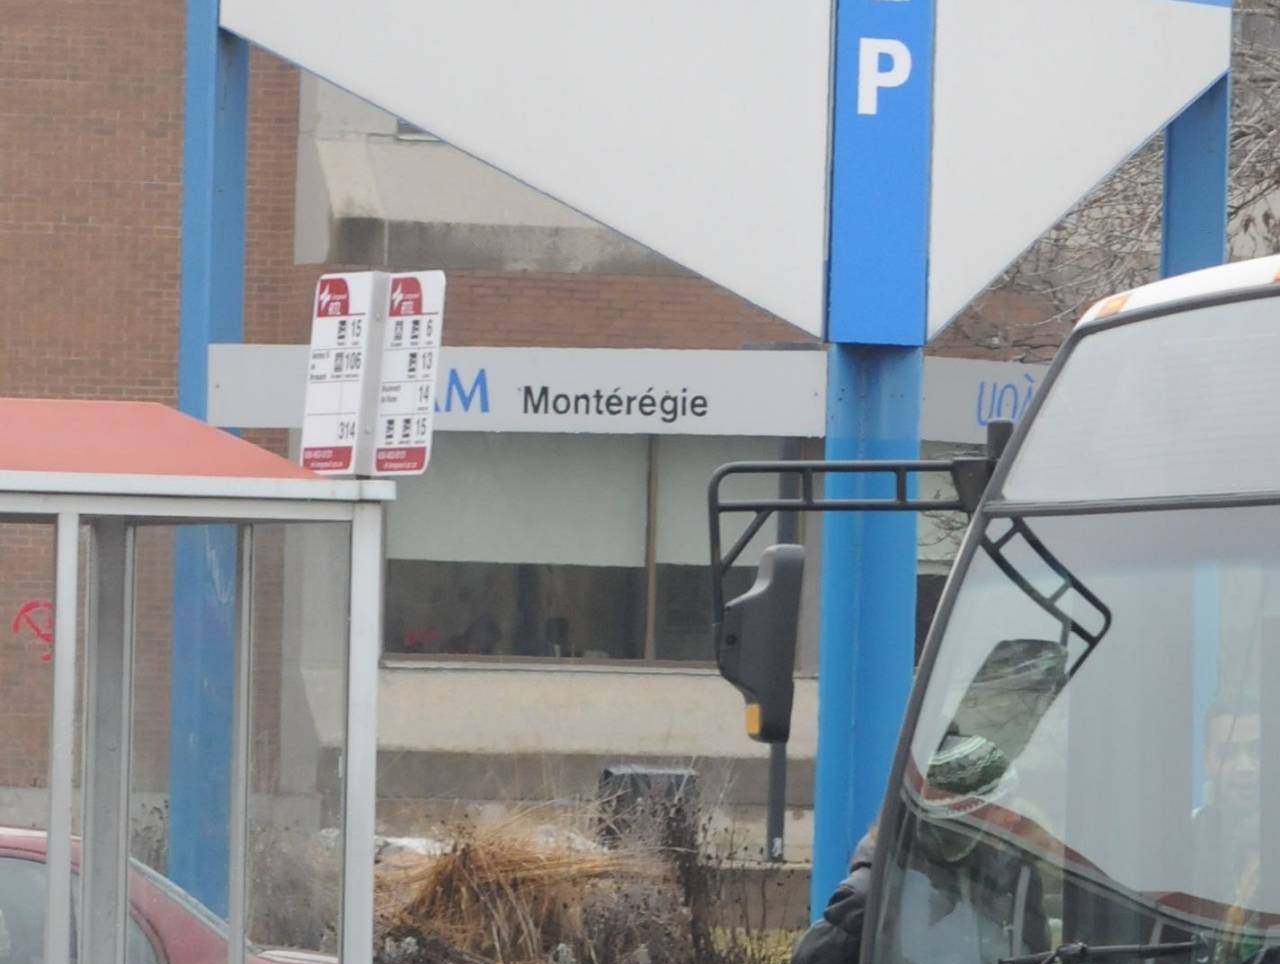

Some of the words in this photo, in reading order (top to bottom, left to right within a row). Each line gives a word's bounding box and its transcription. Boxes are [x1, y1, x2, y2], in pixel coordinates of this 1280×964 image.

[857, 37, 912, 115] P
[345, 352, 362, 370] 106
[522, 385, 708, 423] Montérégie
